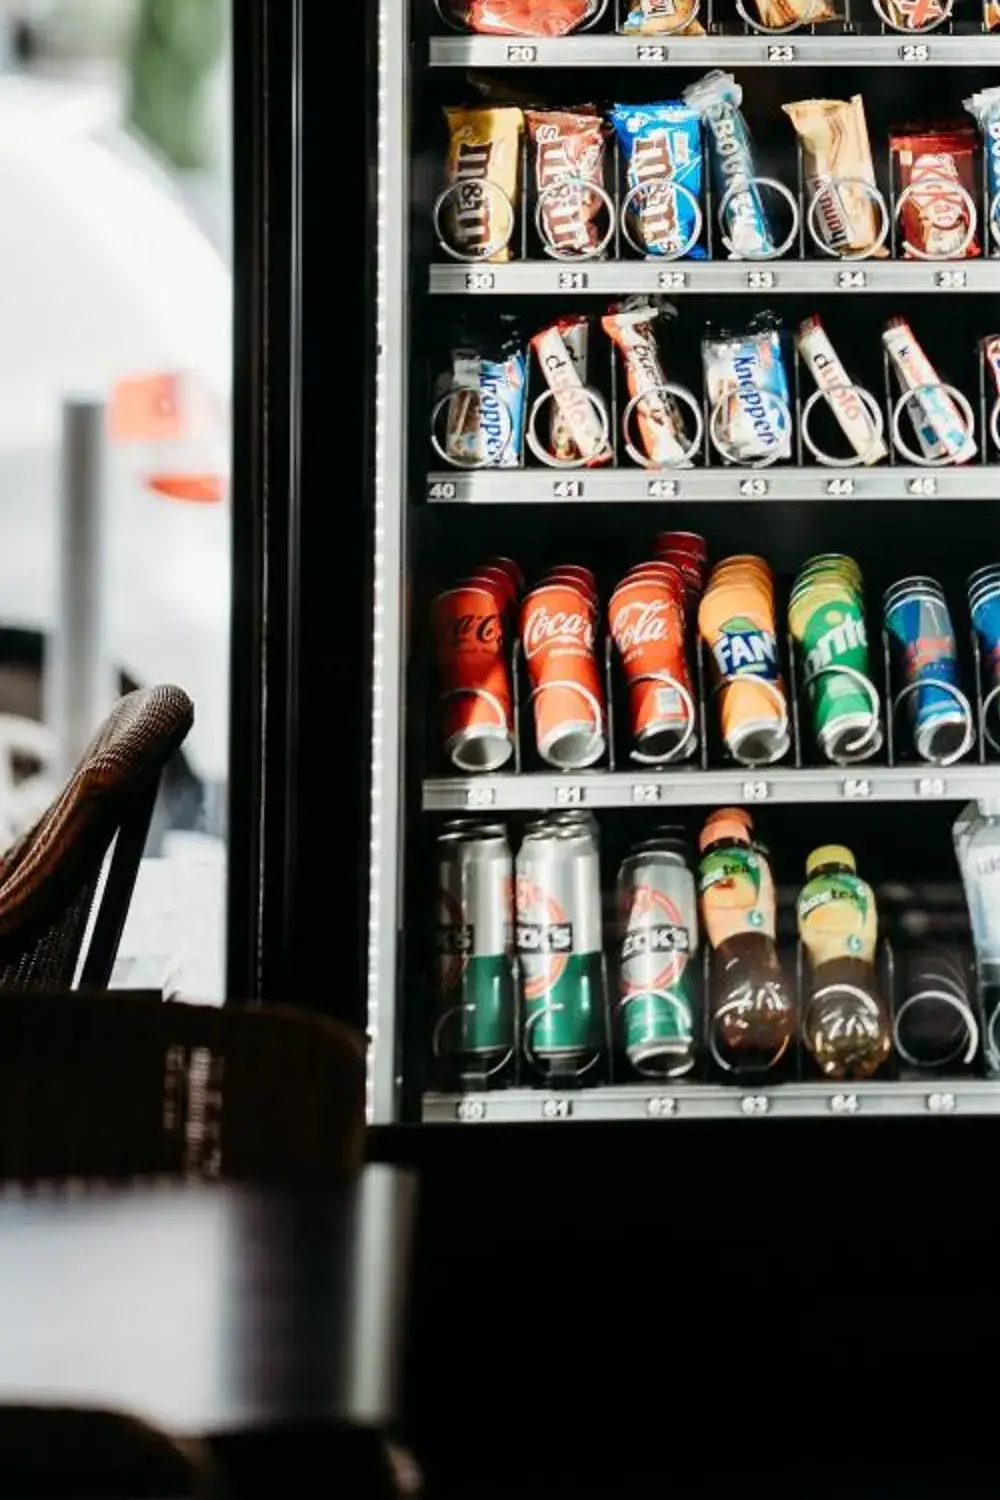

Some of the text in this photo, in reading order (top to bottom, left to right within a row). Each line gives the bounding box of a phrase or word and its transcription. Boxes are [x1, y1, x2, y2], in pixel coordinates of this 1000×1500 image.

[508, 47, 532, 61] 20
[638, 47, 663, 61] 22
[769, 46, 795, 61] 23
[429, 483, 455, 497] 40
[555, 483, 579, 498] 41
[741, 480, 767, 495] 43
